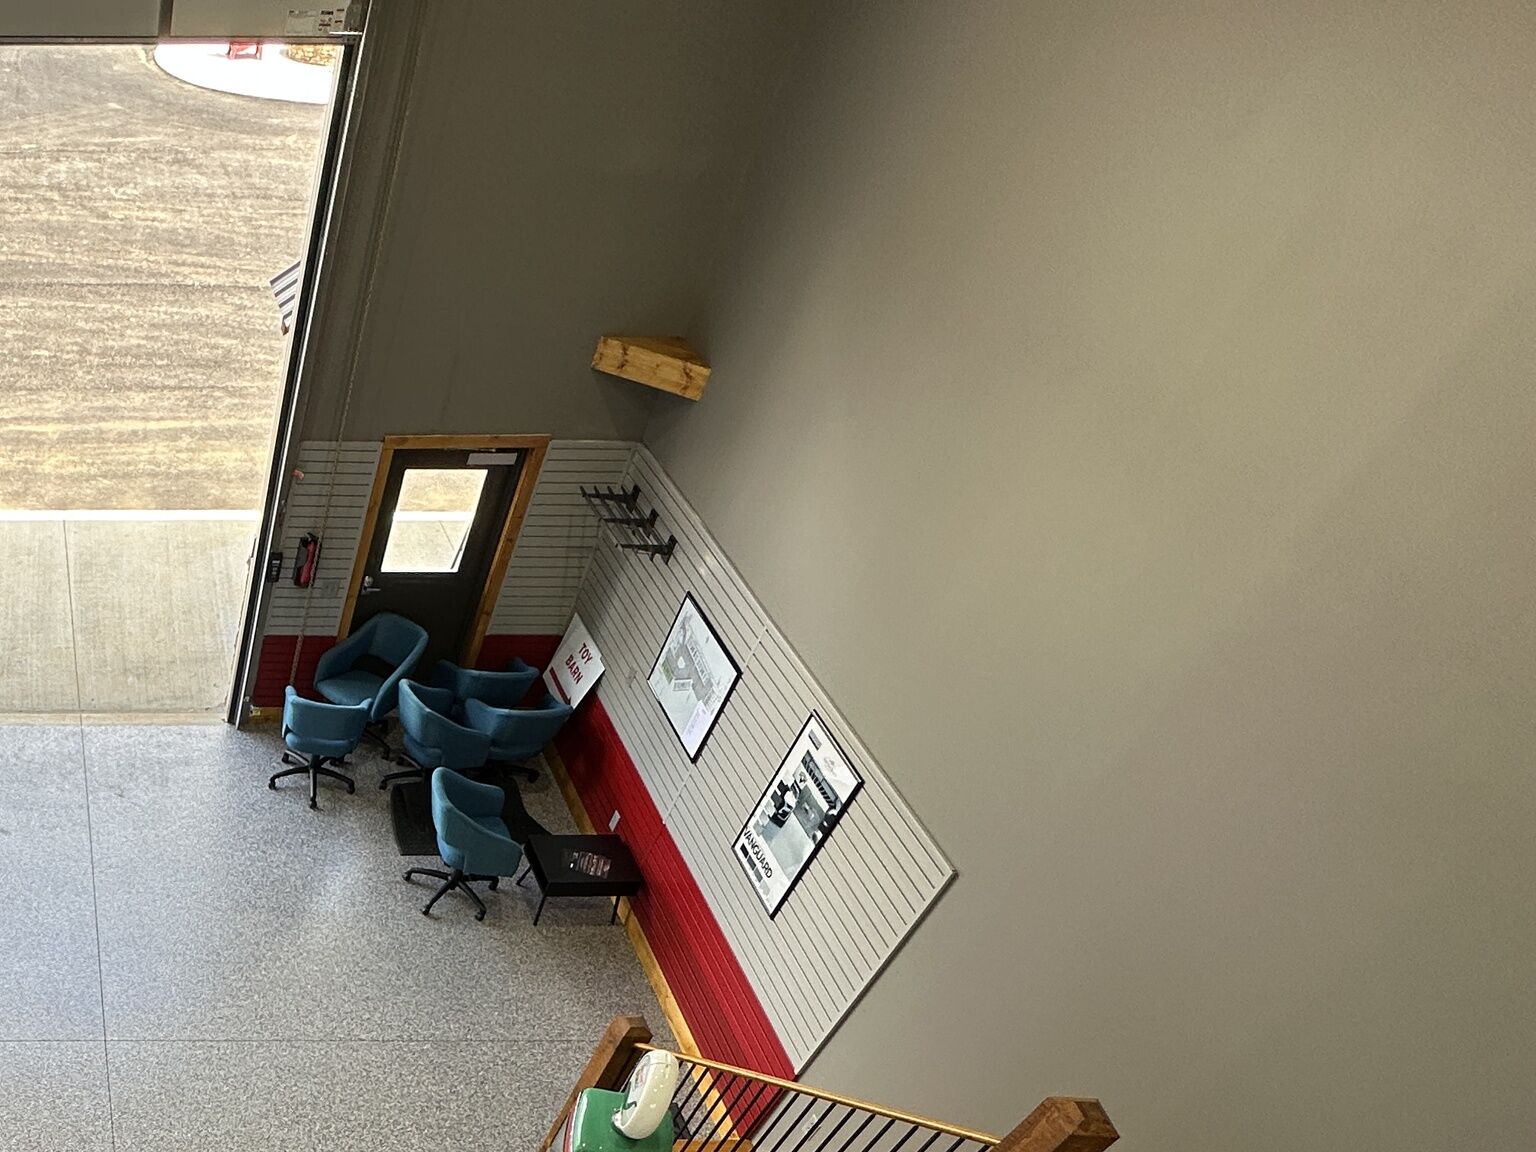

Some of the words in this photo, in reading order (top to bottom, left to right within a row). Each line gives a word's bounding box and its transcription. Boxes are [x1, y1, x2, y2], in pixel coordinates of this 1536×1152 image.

[577, 642, 594, 664] TOY
[564, 654, 584, 686] BARN
[742, 827, 773, 879] VANGUARD
